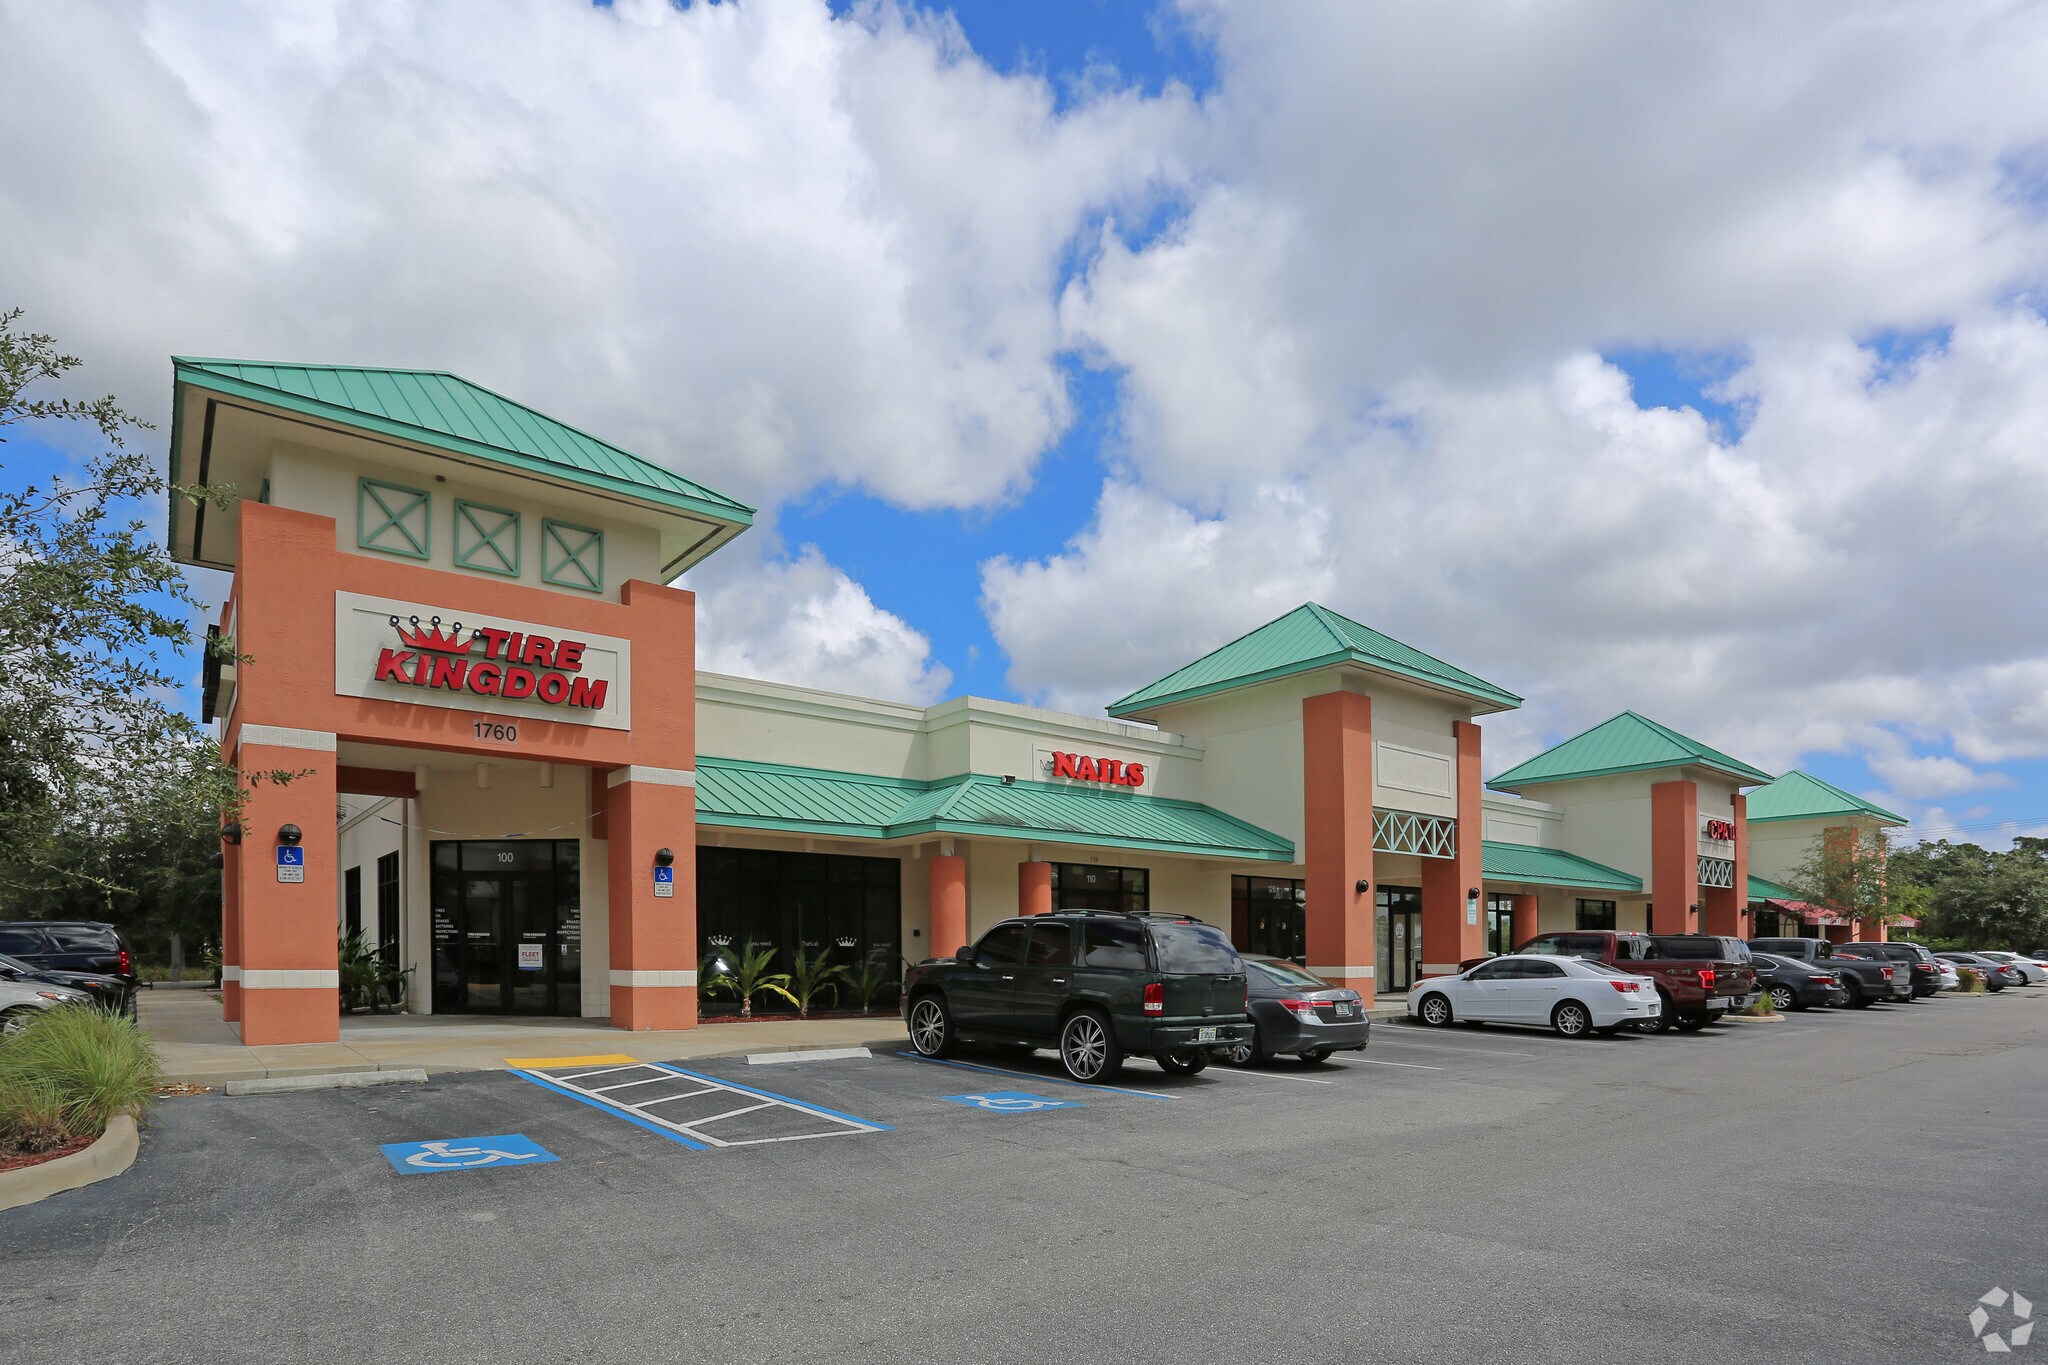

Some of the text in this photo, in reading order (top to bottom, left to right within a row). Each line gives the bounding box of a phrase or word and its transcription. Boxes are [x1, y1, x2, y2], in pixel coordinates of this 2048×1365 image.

[480, 626, 586, 672] TIRE
[374, 648, 608, 710] KINGDOM
[474, 722, 517, 742] 1760
[1052, 751, 1145, 787] NAILS
[1708, 820, 1729, 841] CPA
[497, 852, 514, 863] 100
[1086, 874, 1097, 884] 110
